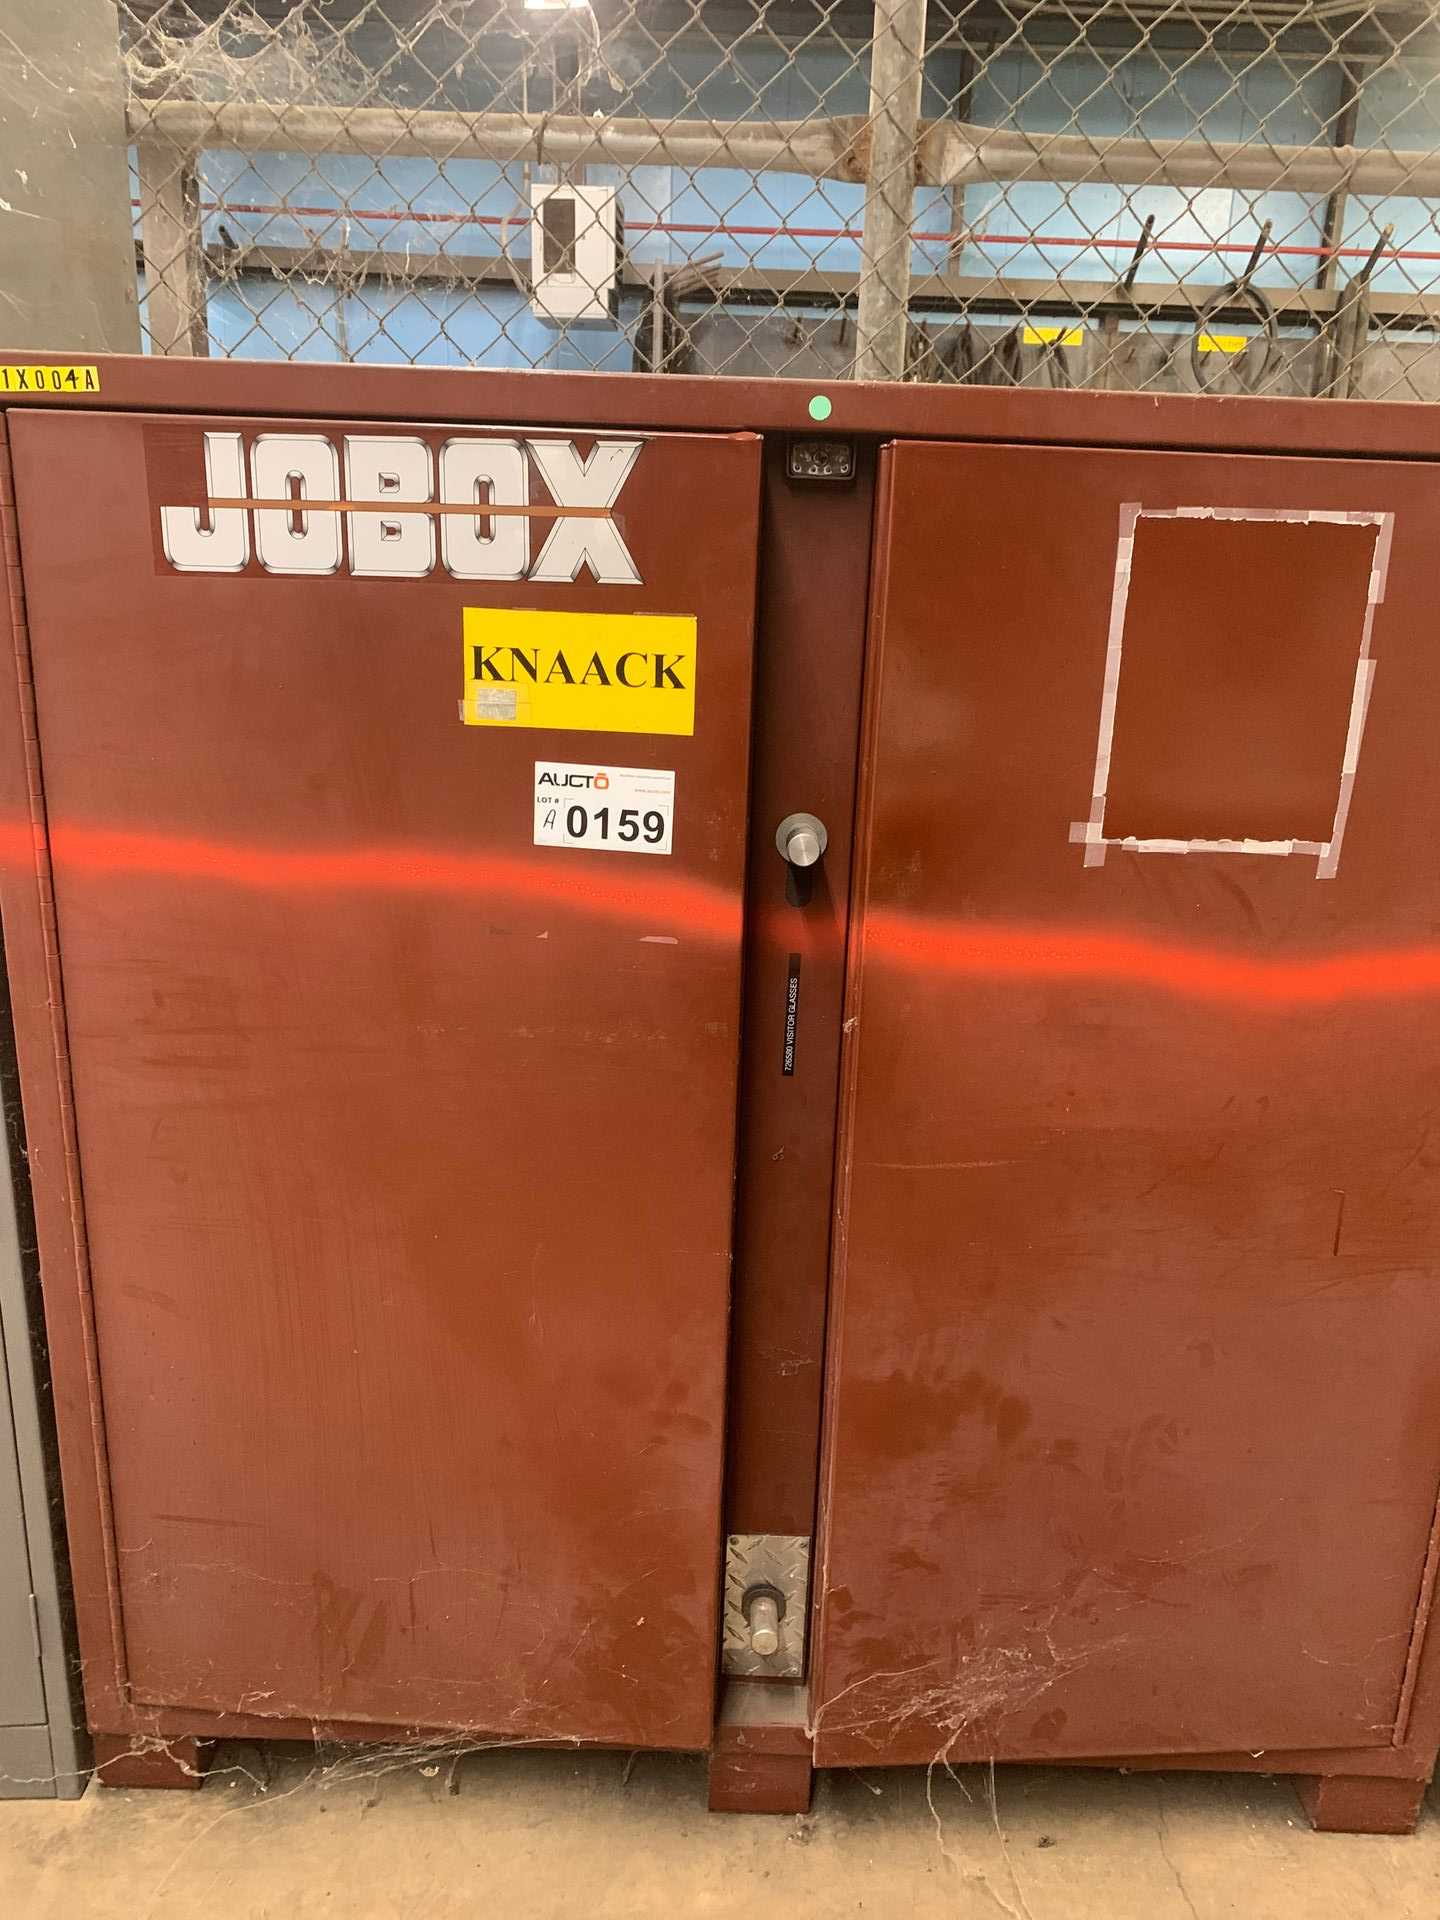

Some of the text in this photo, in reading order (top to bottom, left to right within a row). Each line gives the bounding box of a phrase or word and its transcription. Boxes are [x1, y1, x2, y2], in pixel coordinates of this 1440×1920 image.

[1, 368, 94, 390] 1X004A
[160, 431, 644, 585] JOBOX
[470, 645, 688, 690] KNAACK
[536, 796, 552, 804] LOT
[543, 808, 557, 830] A
[566, 805, 666, 843] 0159
[788, 977, 798, 1014] GLASSES
[786, 1014, 796, 1045] VISITOR
